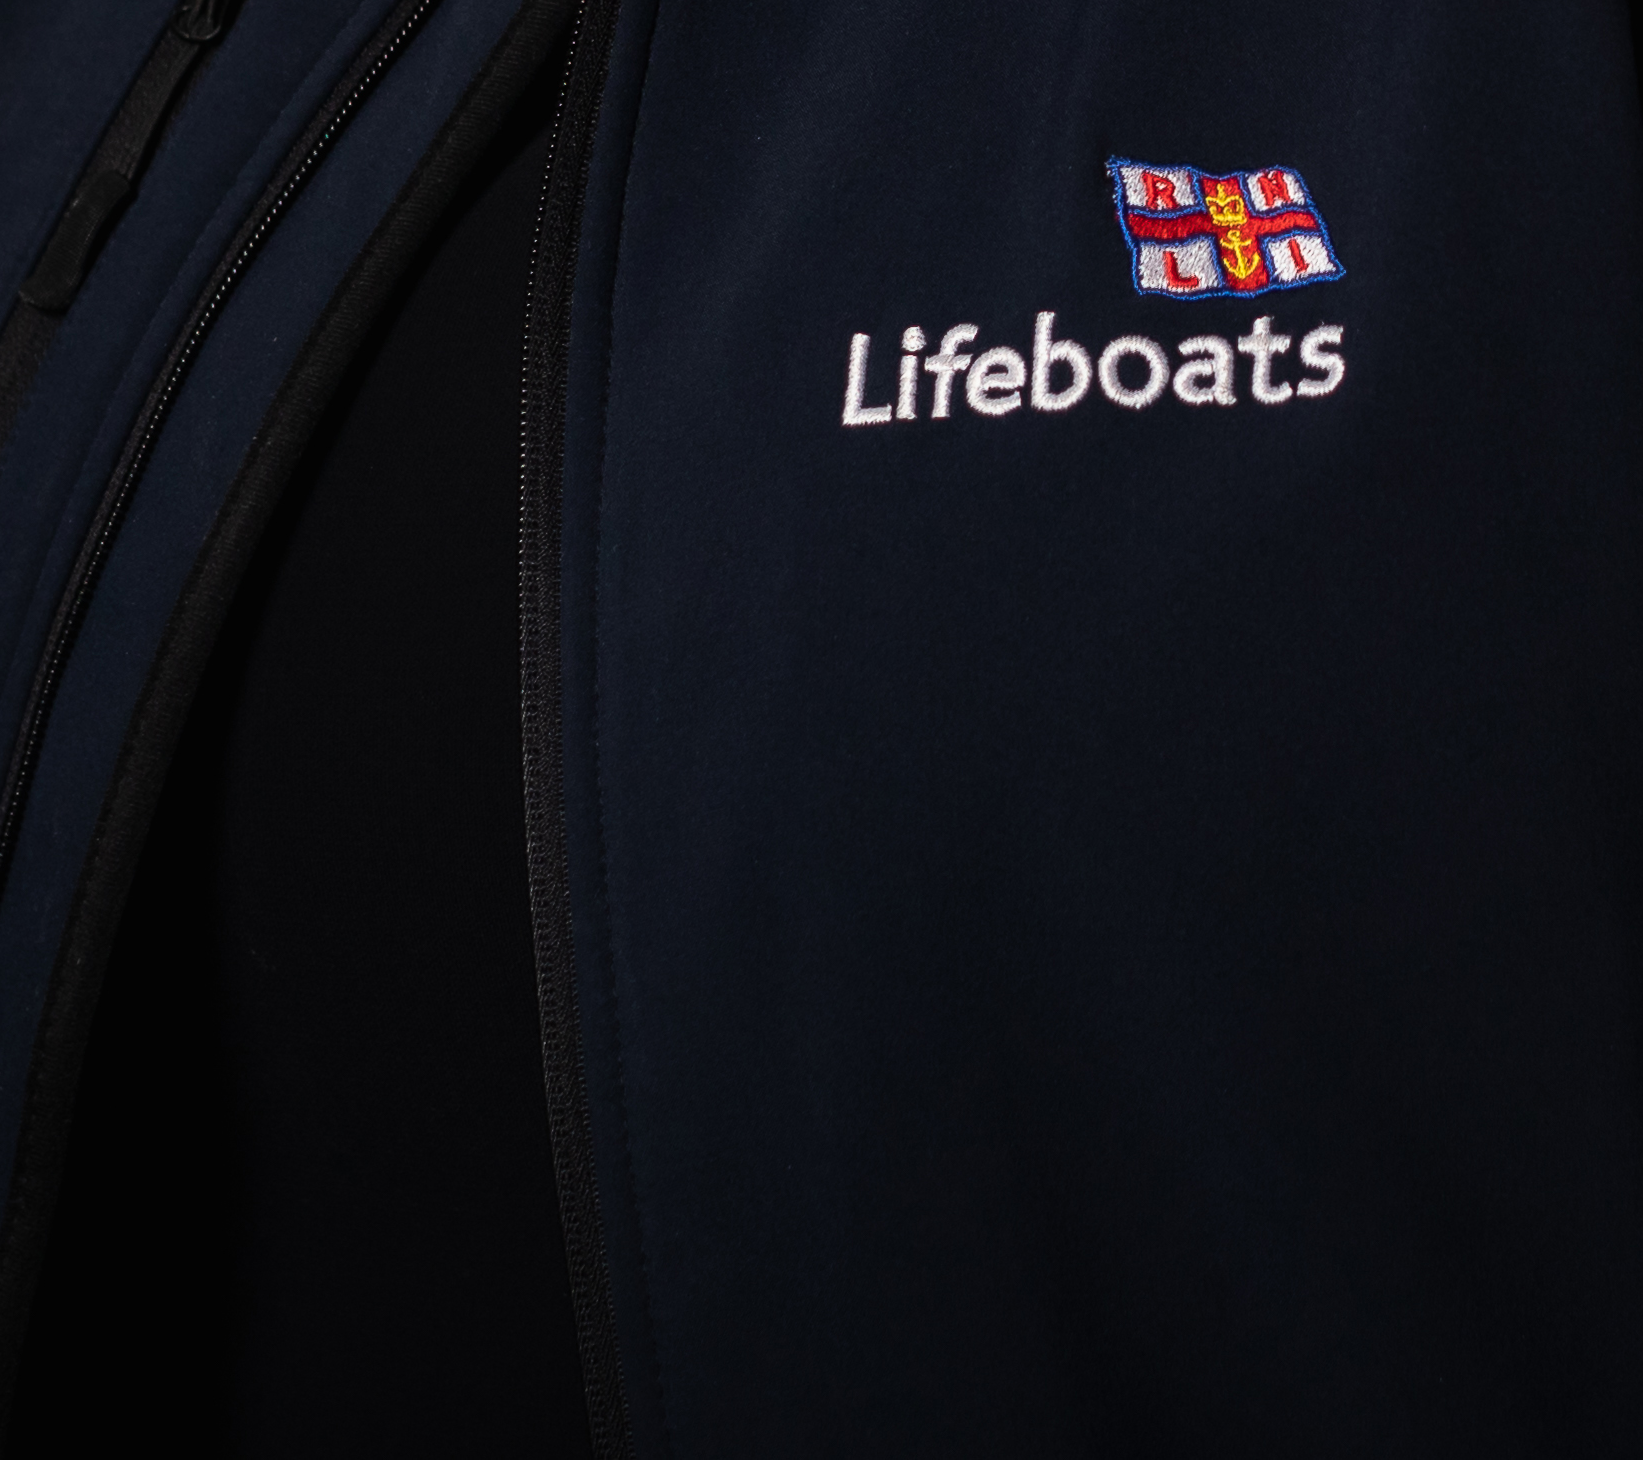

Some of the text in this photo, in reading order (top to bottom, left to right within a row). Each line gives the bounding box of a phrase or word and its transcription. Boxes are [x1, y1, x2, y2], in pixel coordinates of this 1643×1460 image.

[1142, 172, 1178, 209] R
[1163, 238, 1308, 289] L I
[841, 310, 1347, 427] Lifeboats
